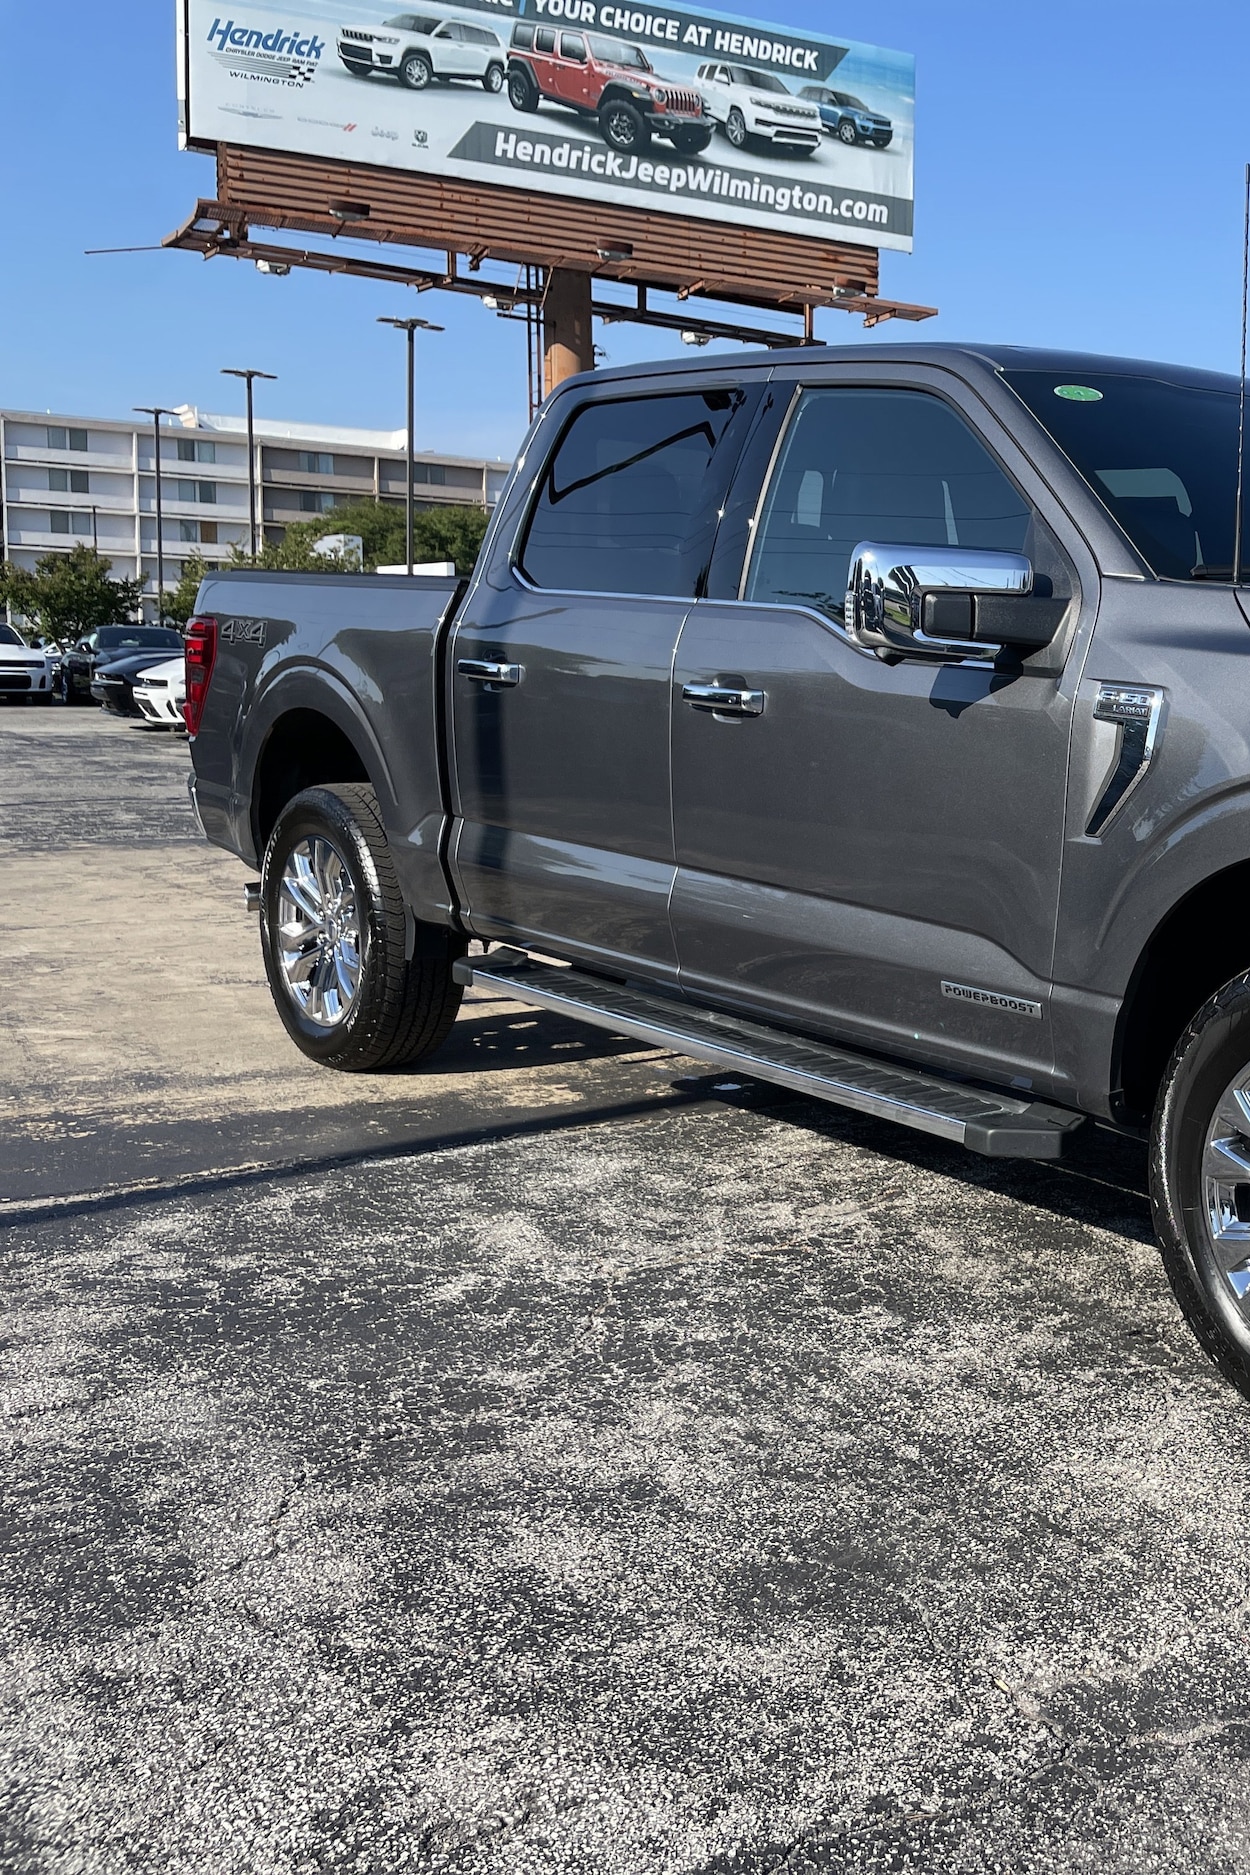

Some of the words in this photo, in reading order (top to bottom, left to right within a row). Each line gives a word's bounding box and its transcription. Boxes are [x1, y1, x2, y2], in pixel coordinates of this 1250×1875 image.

[206, 18, 326, 60] Hendrick
[535, 0, 597, 24] YOUR
[599, 5, 681, 41] CHOICE
[682, 24, 712, 47] AT
[714, 29, 819, 72] HENDRICK
[225, 46, 256, 57] CHRYSLER
[255, 52, 277, 61] DODGE
[276, 55, 291, 63] JEEP
[229, 70, 304, 89] WILMINGTON
[494, 131, 889, 224] HendrickJeepWilmington.com
[1112, 704, 1149, 717] LARIAT
[944, 984, 1035, 1014] POWERBOOST
